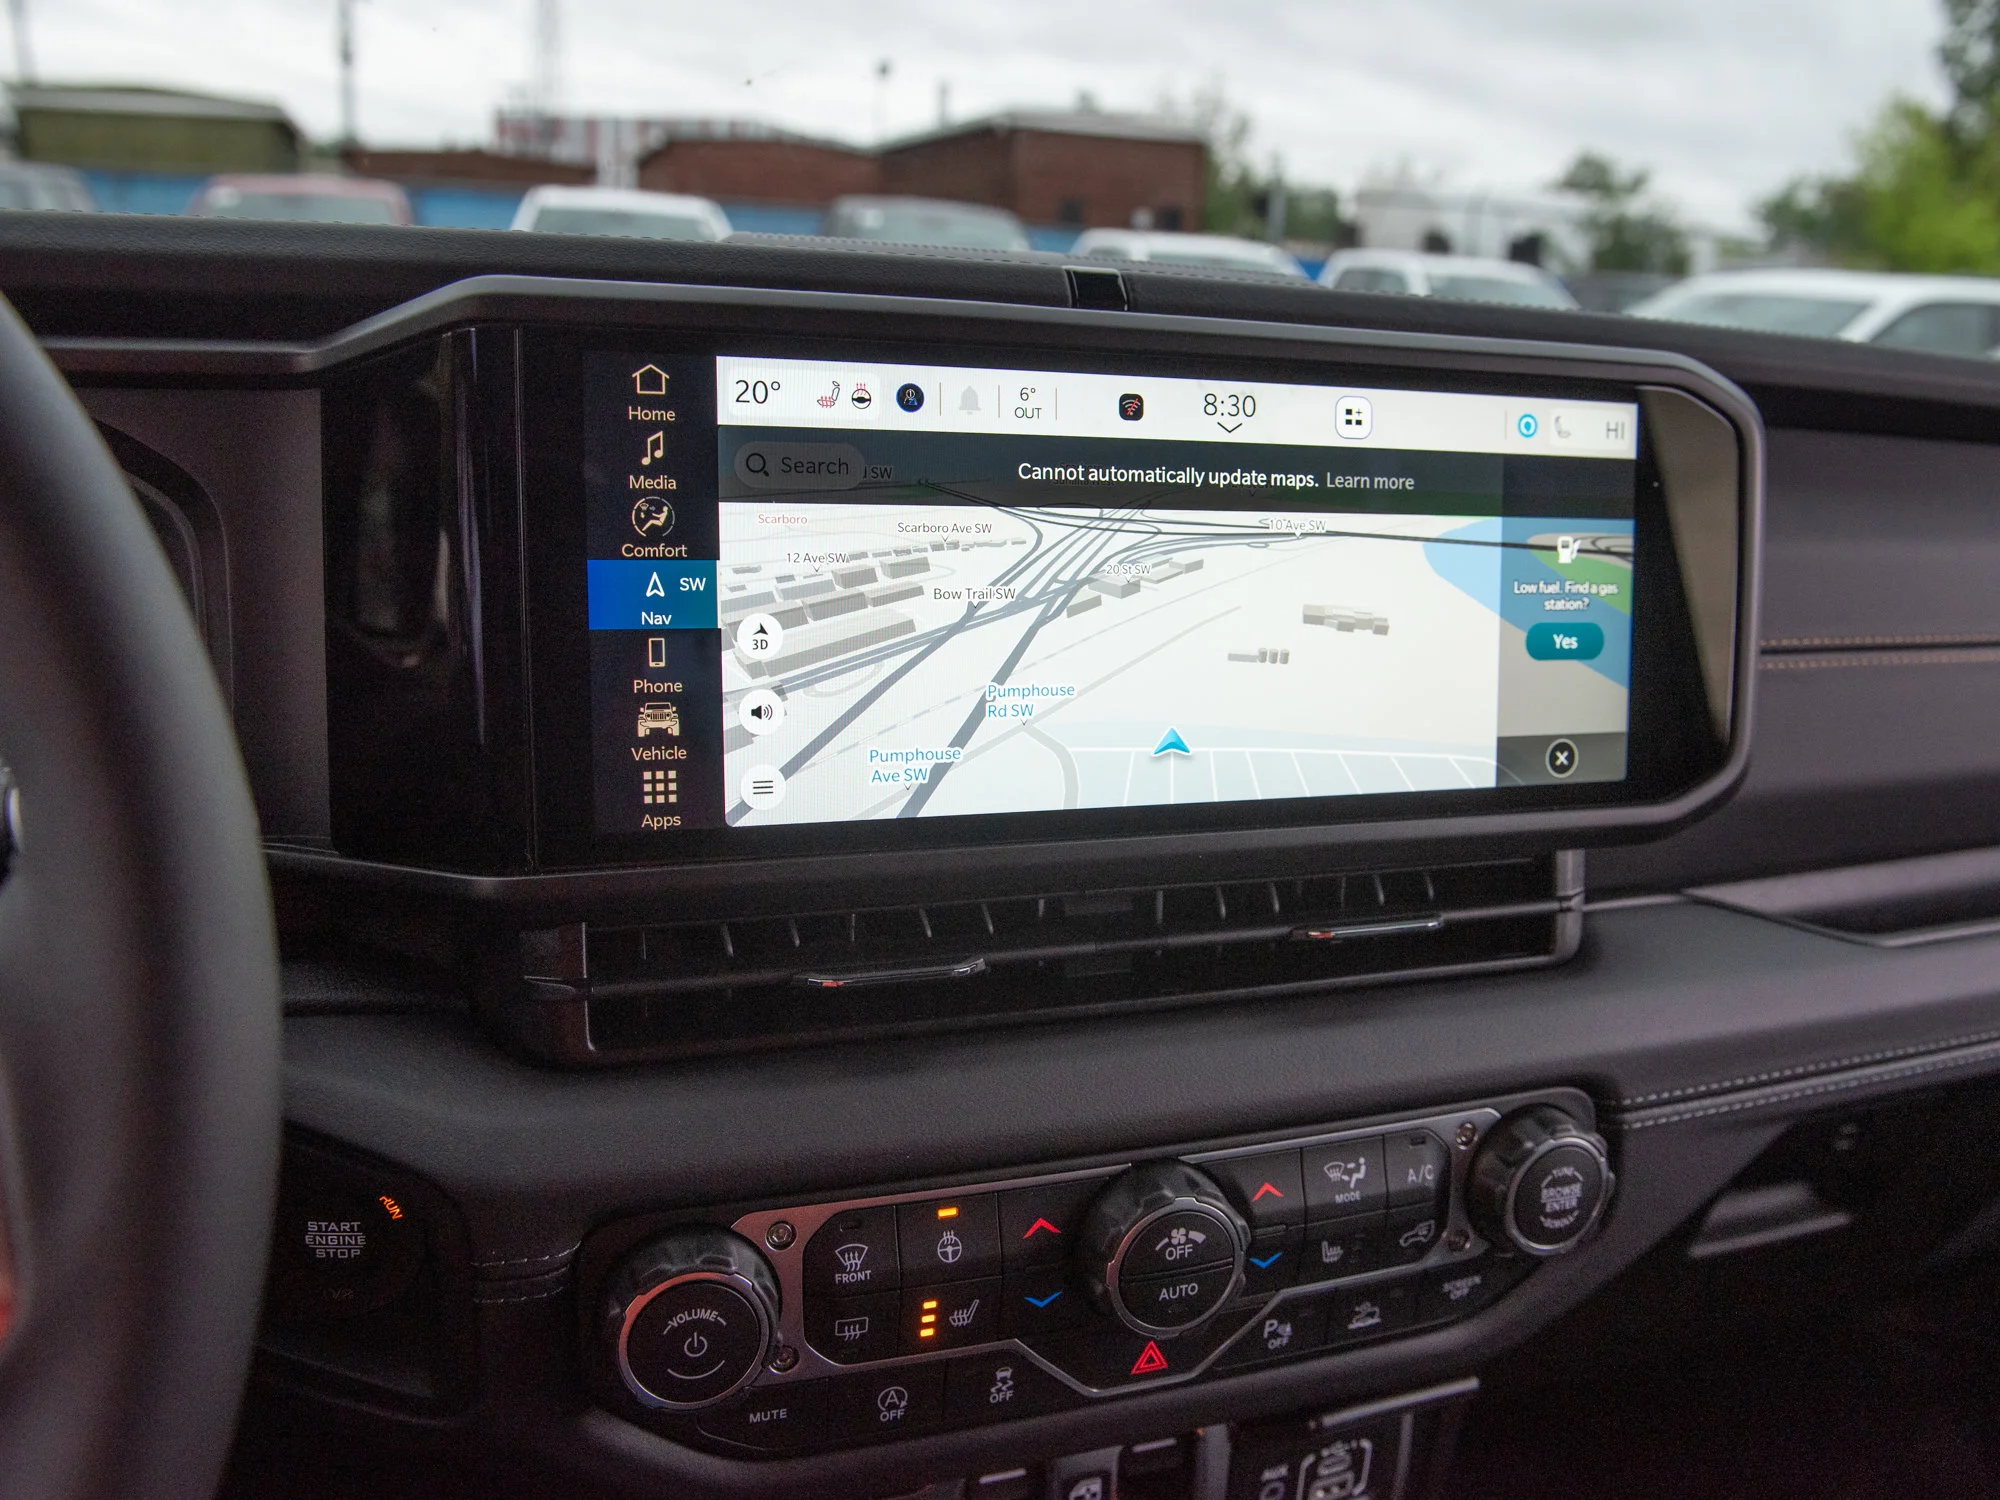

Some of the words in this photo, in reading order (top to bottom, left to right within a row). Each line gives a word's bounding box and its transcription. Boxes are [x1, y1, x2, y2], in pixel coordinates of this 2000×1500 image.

[735, 380, 781, 405] 20°
[1020, 387, 1037, 401] 6°
[1203, 393, 1257, 418] 8:30
[628, 406, 676, 422] Home
[1014, 407, 1042, 420] OUT
[1606, 421, 1626, 441] HI
[781, 457, 849, 476] Search
[871, 466, 892, 480] SW
[629, 475, 677, 490] Media
[1018, 462, 1085, 482] Cannot
[1088, 465, 1205, 487] automatically
[1208, 469, 1267, 490] update
[1270, 473, 1319, 490] maps.
[1327, 472, 1370, 489] Learn
[1374, 476, 1415, 491] more
[758, 514, 808, 525] Scarboro
[1269, 520, 1283, 531] 10
[1284, 520, 1306, 531] Ave
[1308, 520, 1327, 532] SW
[897, 522, 948, 534] Scarboro
[951, 523, 970, 534] Ave
[974, 523, 993, 534] SW
[621, 543, 688, 558] Comfort
[786, 553, 799, 564] 12
[802, 553, 825, 564] Ave
[827, 552, 847, 564] SW
[1106, 564, 1120, 575] 20
[1122, 564, 1132, 576] St
[1133, 564, 1151, 576] SW
[680, 577, 706, 592] SW
[1513, 581, 1537, 594] Low
[1538, 581, 1563, 594] fuel.
[1565, 581, 1590, 594] Find
[1590, 584, 1597, 594] a
[1598, 584, 1619, 597] gas
[933, 588, 962, 600] Bow
[965, 588, 994, 600] Trail
[995, 588, 1016, 600] SW
[1543, 597, 1590, 611] station?
[641, 611, 672, 625] Nav
[752, 638, 769, 651] 3D
[1552, 634, 1578, 650] Yes
[633, 679, 683, 694] Phone
[988, 684, 1075, 700] Pumphouse
[988, 704, 1007, 718] Rd
[1010, 703, 1034, 717] SW
[631, 746, 687, 761] Vehicle
[869, 748, 961, 764] Pumphouse
[872, 769, 900, 783] Ave
[904, 768, 928, 781] SW
[641, 813, 681, 830] Apps
[1408, 1164, 1435, 1184] A/C
[1335, 1191, 1361, 1203] MODE
[379, 1196, 403, 1220] RUN
[307, 1221, 361, 1232] START
[305, 1235, 366, 1245] ENGINE
[316, 1248, 361, 1259] STOP
[1165, 1244, 1193, 1261] OFF
[835, 1270, 871, 1284] FRONT
[1159, 1283, 1198, 1301] AUTO
[669, 1309, 718, 1328] VOLUME
[1268, 1337, 1289, 1350] OFF
[990, 1391, 1013, 1403] OFF
[749, 1408, 787, 1424] MUTE
[880, 1409, 904, 1421] OFF
